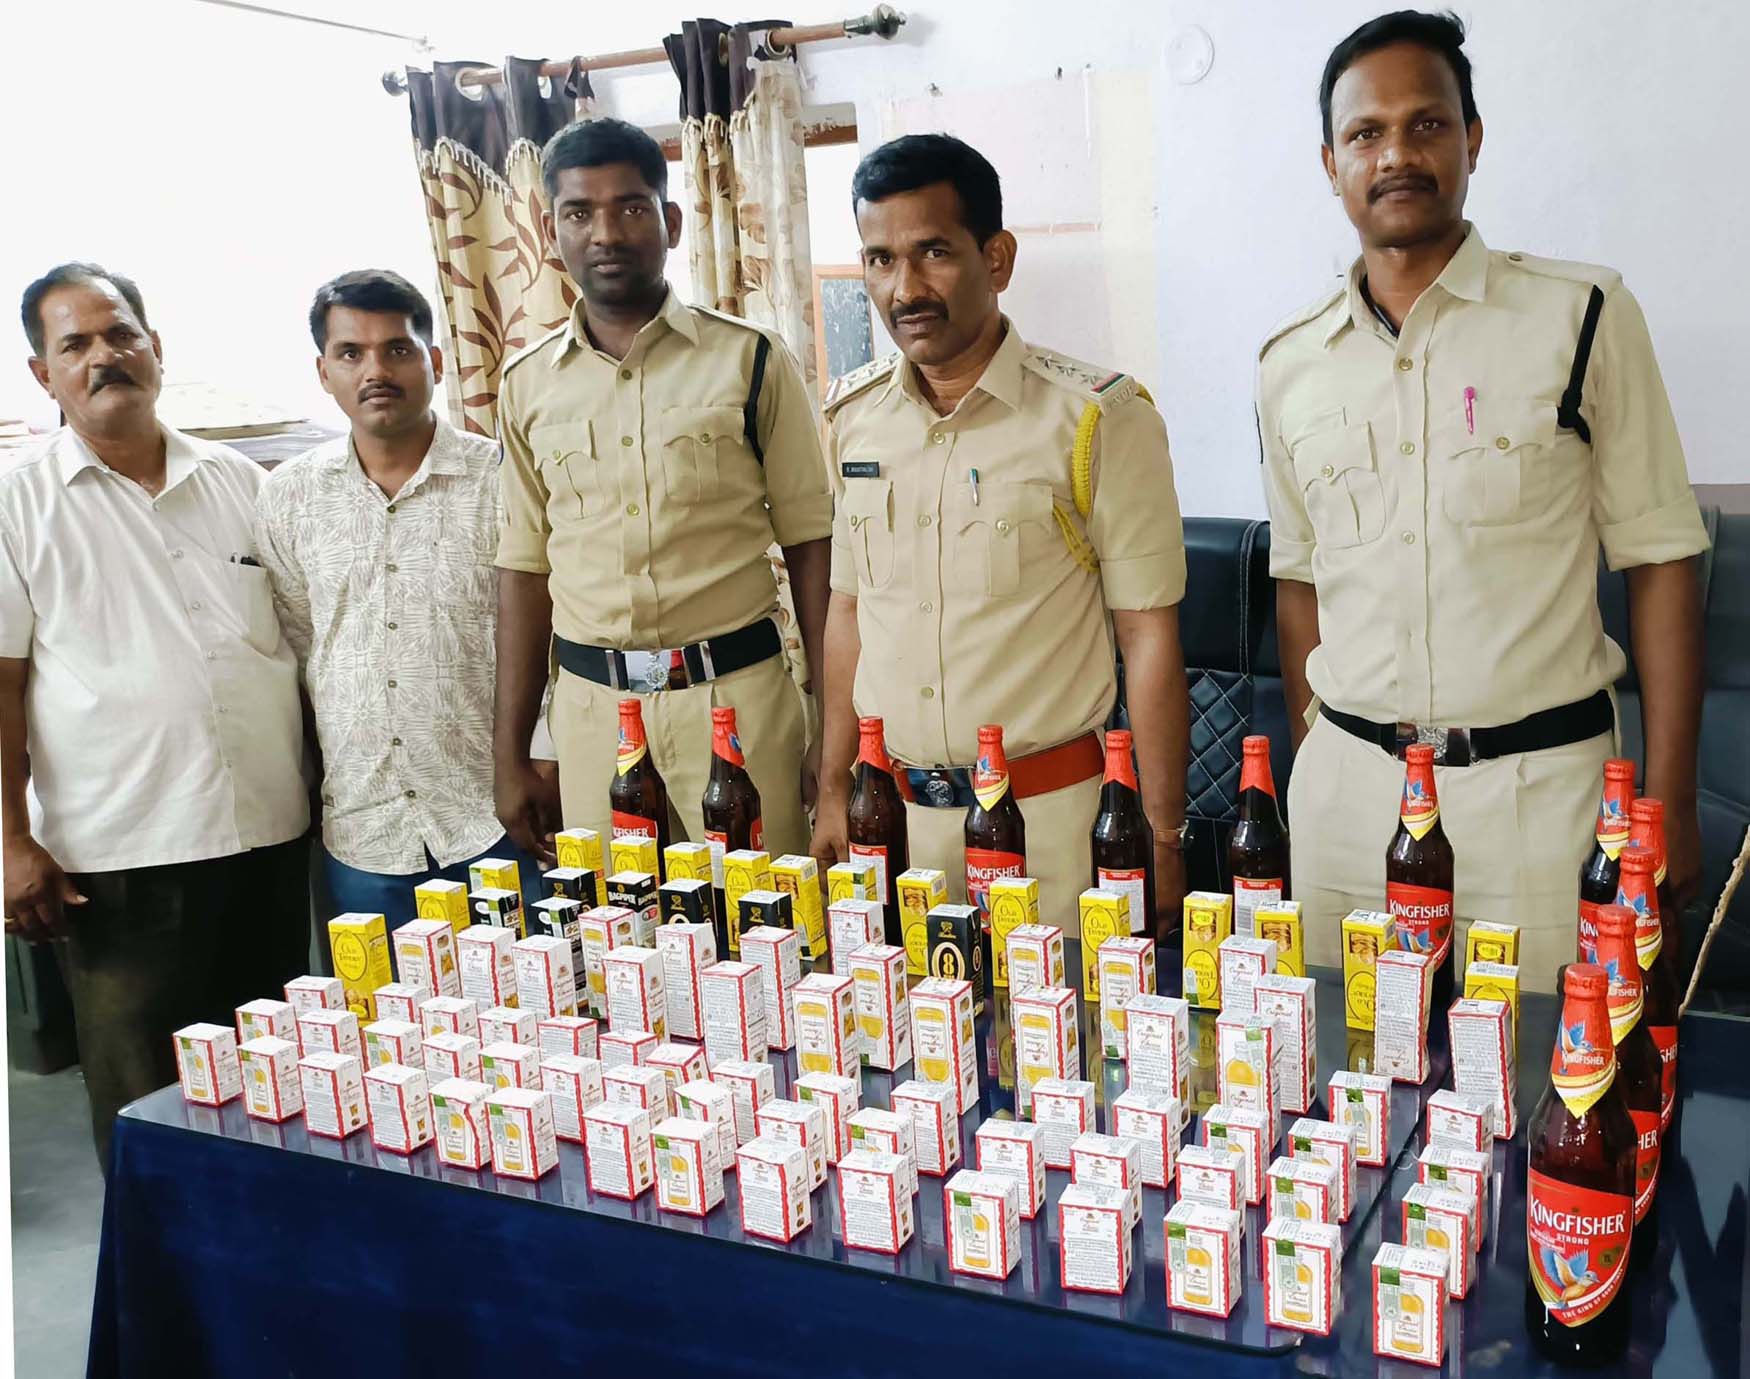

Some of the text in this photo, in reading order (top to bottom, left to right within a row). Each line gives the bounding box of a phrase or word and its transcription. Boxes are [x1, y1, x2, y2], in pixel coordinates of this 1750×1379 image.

[967, 863, 1021, 880] KINGFISHER
[1390, 898, 1450, 918] KINGFISHER
[943, 953, 955, 974] 8
[1530, 1194, 1625, 1236] KINGFISHER
[1556, 1233, 1590, 1245] STRONG
[1562, 1309, 1577, 1319] THE
